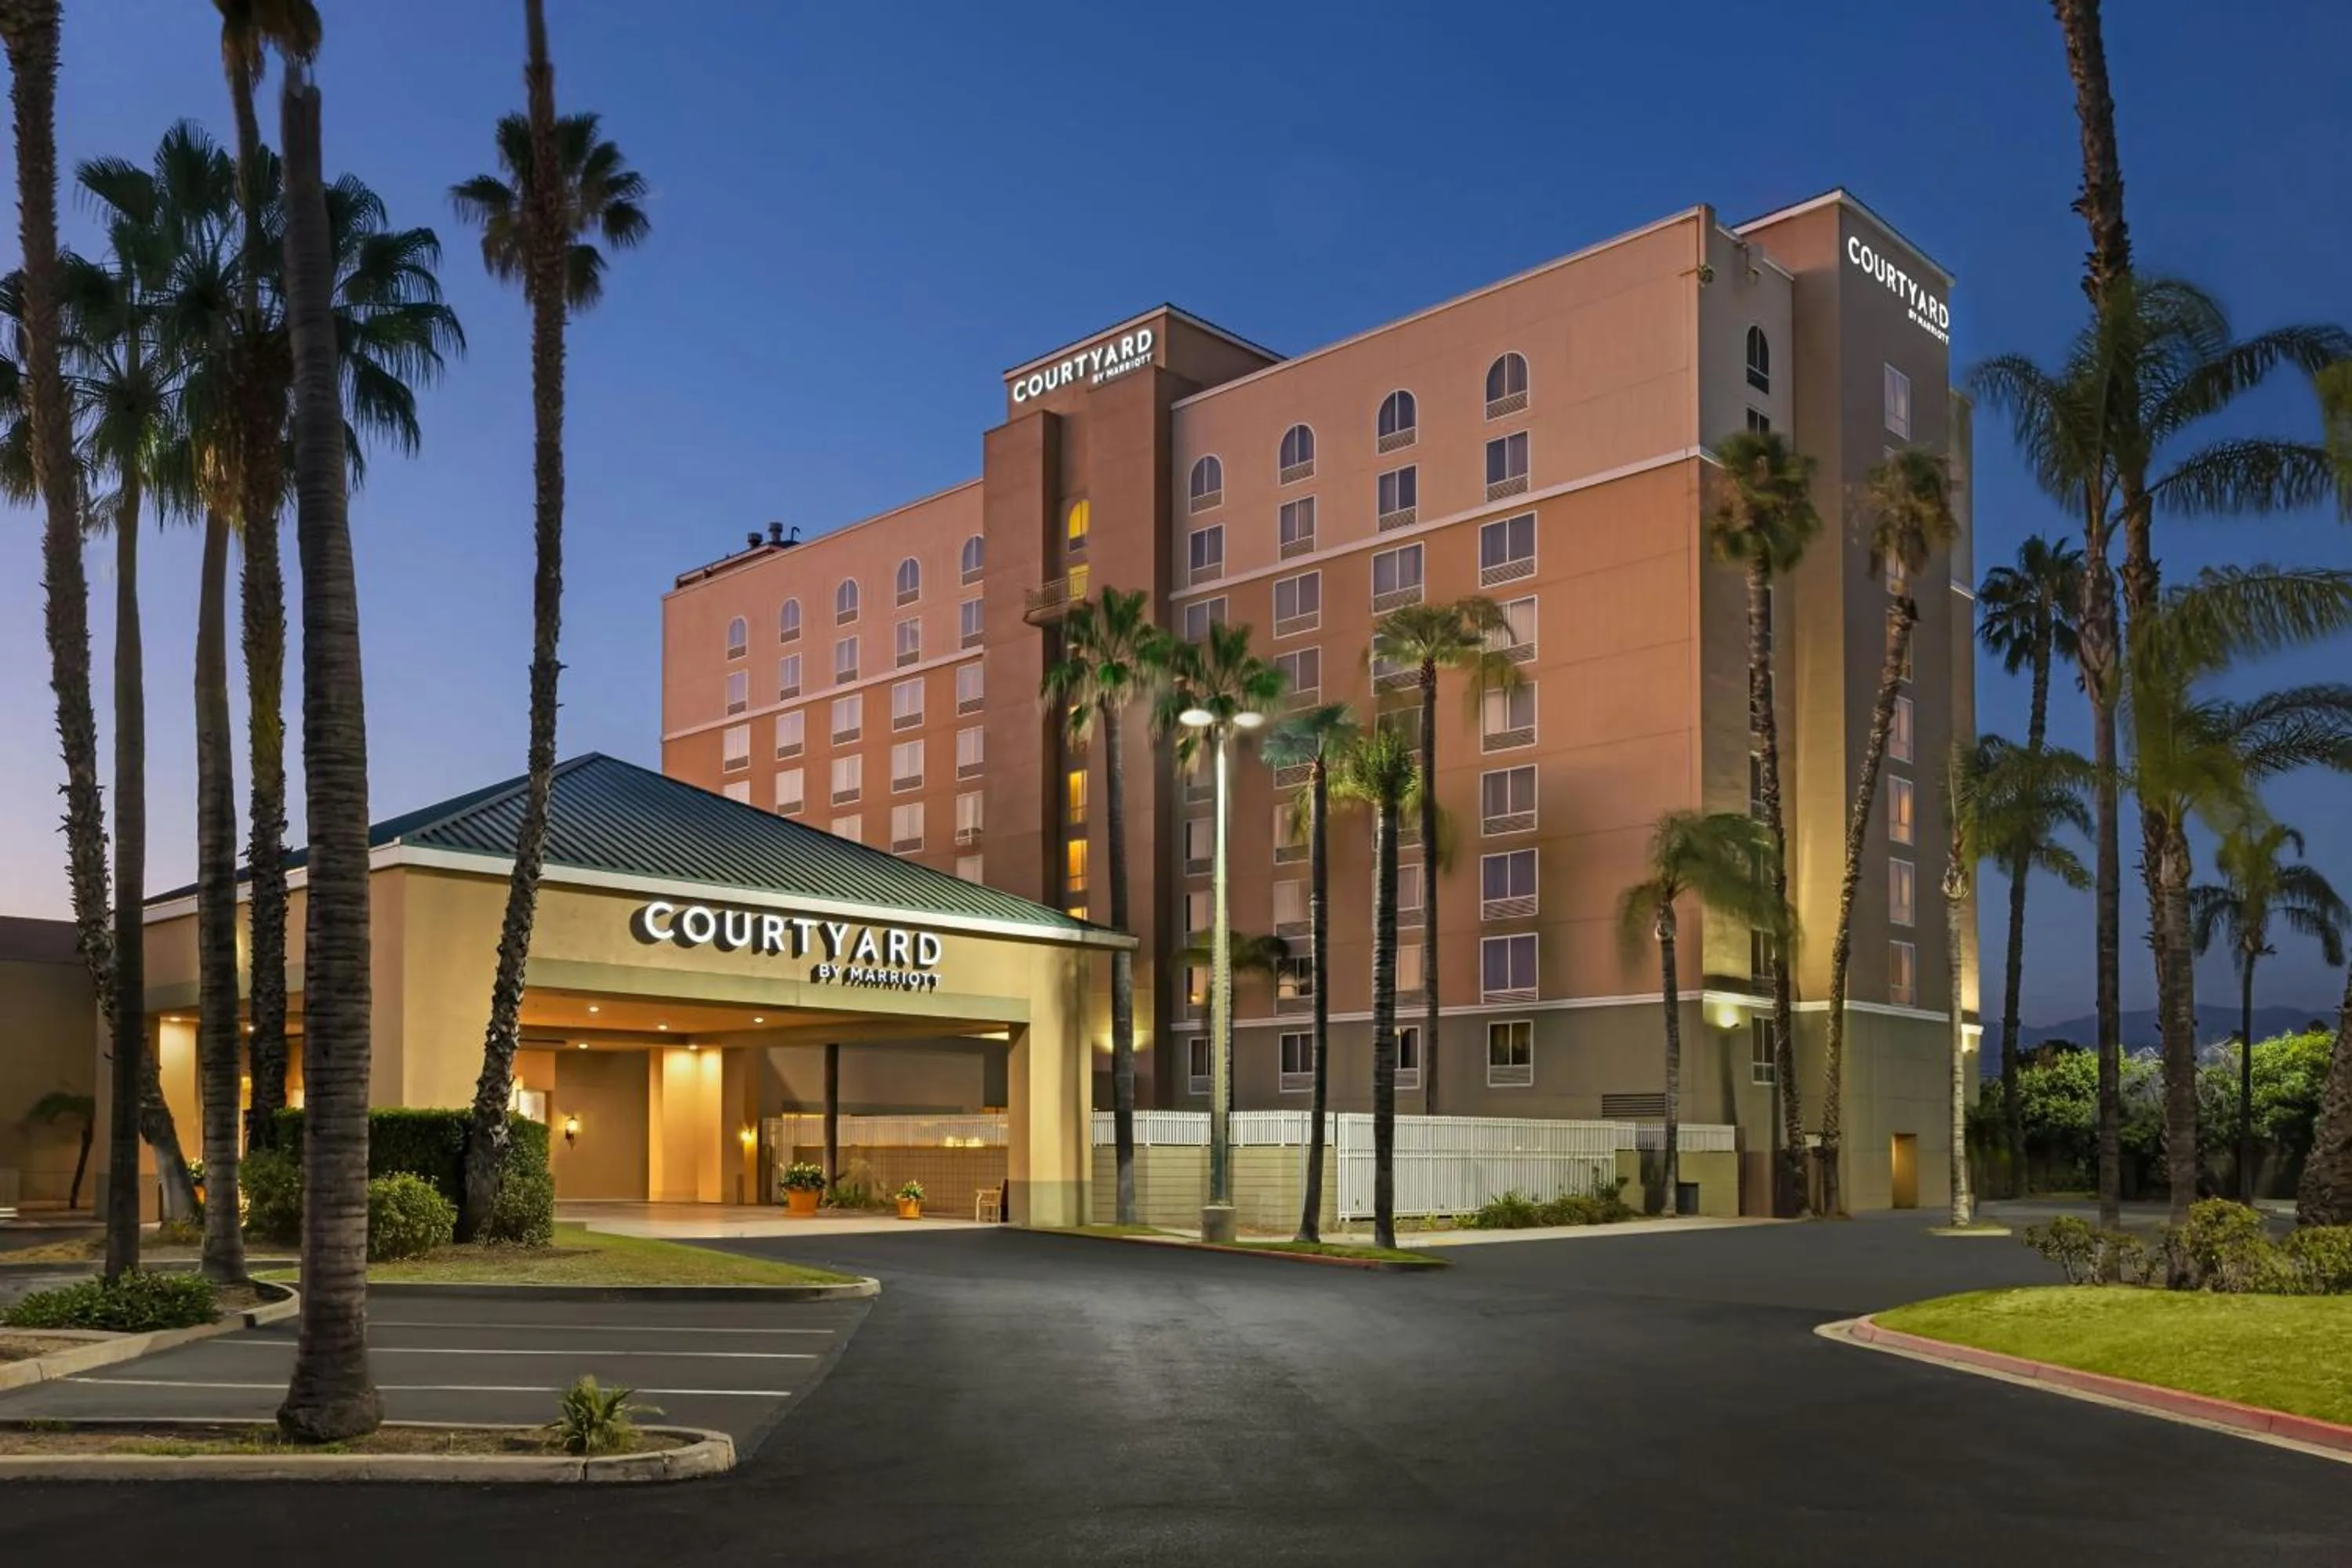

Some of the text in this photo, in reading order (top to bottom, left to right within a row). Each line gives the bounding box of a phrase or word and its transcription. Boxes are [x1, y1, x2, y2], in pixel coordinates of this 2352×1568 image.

[1848, 236, 1950, 329] COURTYARD
[1907, 308, 1917, 321] BY
[1013, 328, 1152, 402] COURTYARD
[1091, 353, 1152, 385] BY MARRIOTT
[643, 901, 942, 967] COURTYARD
[818, 964, 942, 987] BY MARRIOTT
